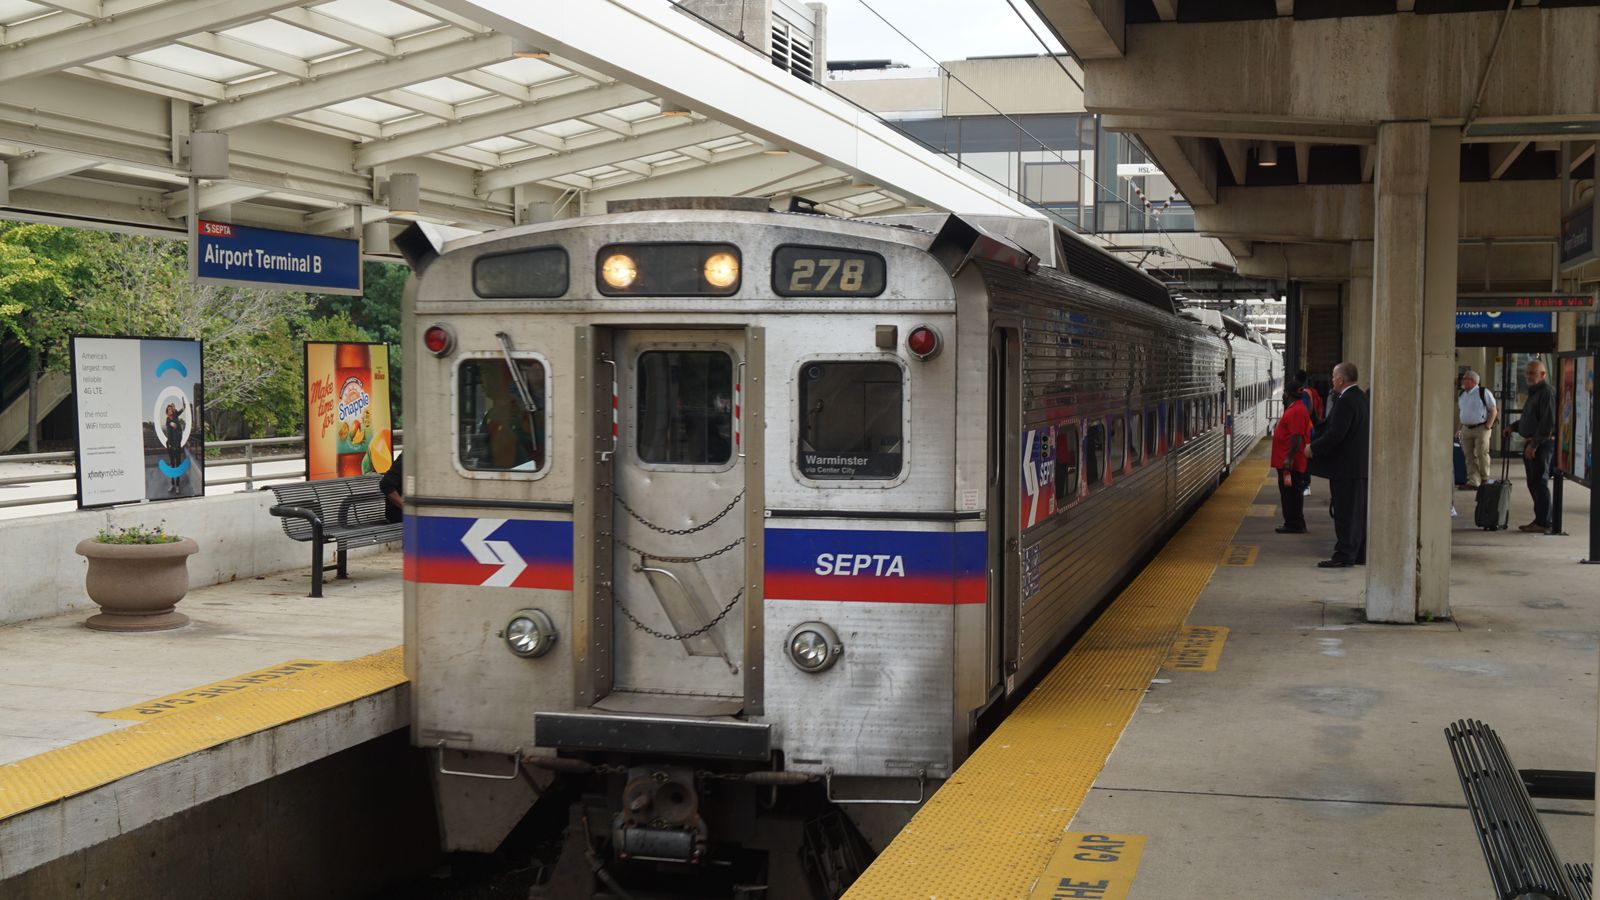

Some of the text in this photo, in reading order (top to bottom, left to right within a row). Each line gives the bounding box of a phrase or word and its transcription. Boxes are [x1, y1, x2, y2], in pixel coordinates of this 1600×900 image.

[211, 224, 231, 235] SEPTA
[204, 243, 322, 273] Airport Terminal B
[789, 259, 865, 291] 278
[1534, 298, 1563, 306] trains
[1502, 323, 1526, 331] Baggage
[81, 352, 107, 360] America's
[83, 387, 103, 395] 4G LTE
[311, 374, 334, 404] Make
[318, 400, 334, 417] time
[339, 392, 369, 421] Snapple
[85, 422, 98, 430] WiFi
[321, 413, 334, 439] for
[805, 455, 868, 467] Warminster
[841, 467, 856, 475] City
[814, 552, 906, 577] SEPTA
[187, 684, 248, 698] THE
[136, 698, 196, 715] GAP
[1051, 834, 1126, 900] HE GAP
